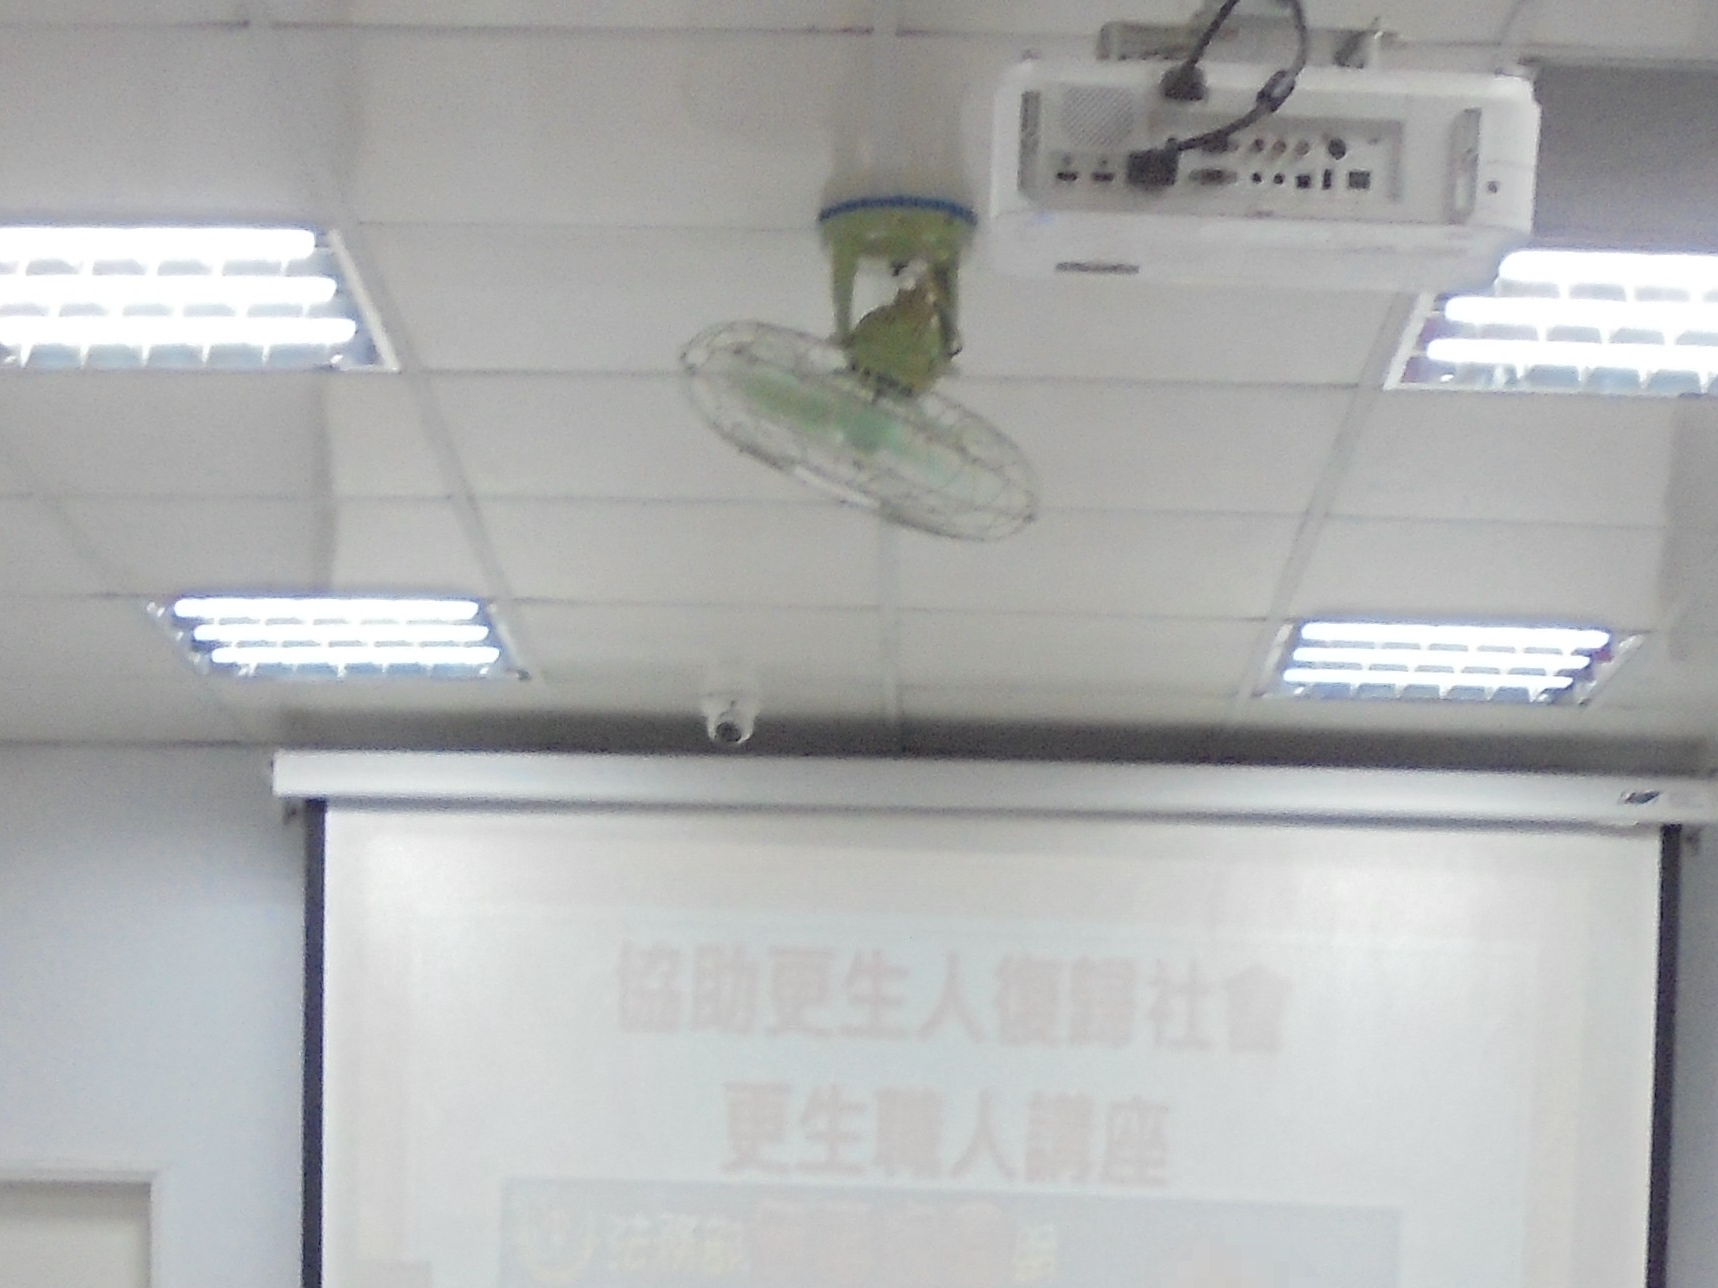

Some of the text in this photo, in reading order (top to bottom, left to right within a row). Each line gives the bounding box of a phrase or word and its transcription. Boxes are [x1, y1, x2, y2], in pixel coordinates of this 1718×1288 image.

[615, 940, 1294, 1056] 協助更生人復歸社會
[721, 1079, 1173, 1188] 更生職人講座
